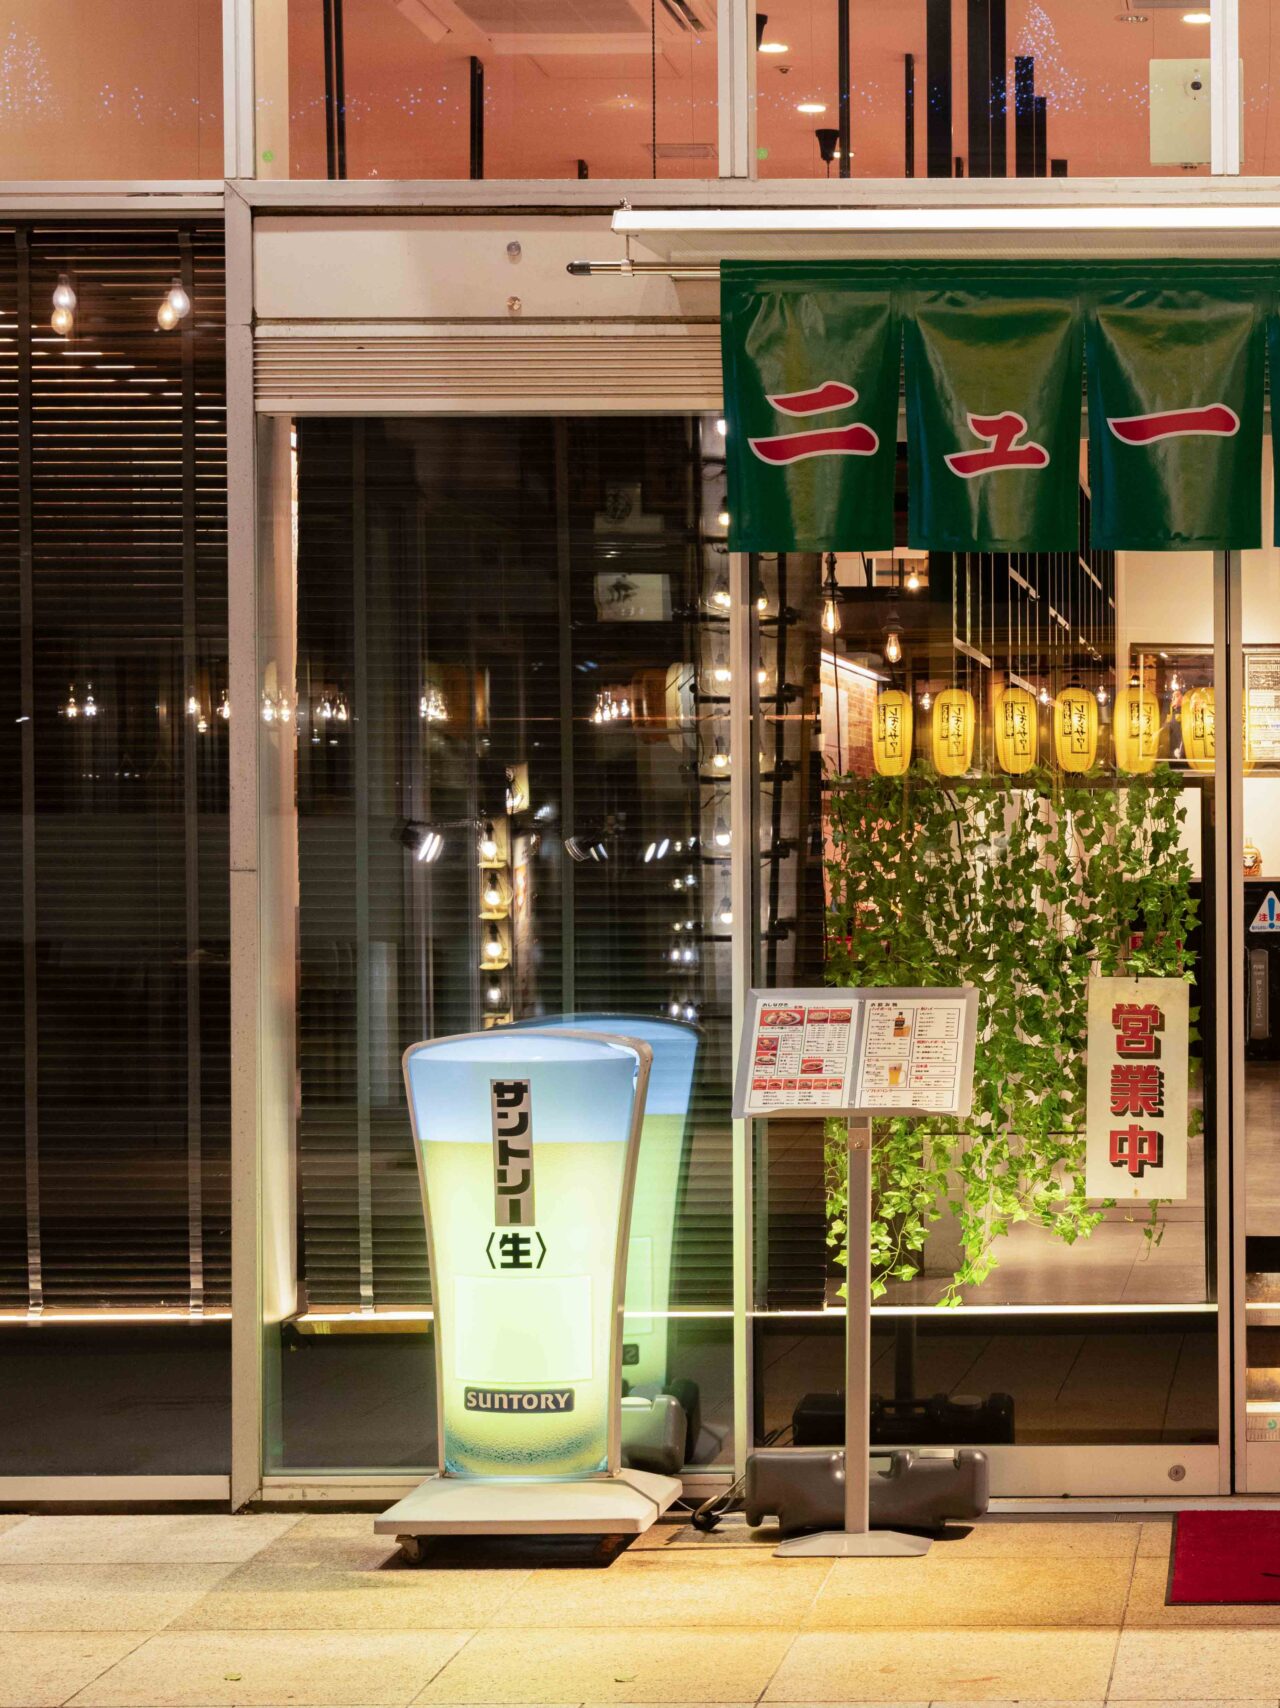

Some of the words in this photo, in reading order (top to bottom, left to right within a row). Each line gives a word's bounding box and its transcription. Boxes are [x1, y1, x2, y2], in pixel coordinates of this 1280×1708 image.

[492, 1080, 532, 1224] サントリー
[1109, 1003, 1164, 1177] 営業中
[466, 1390, 570, 1410] SUNTORY
